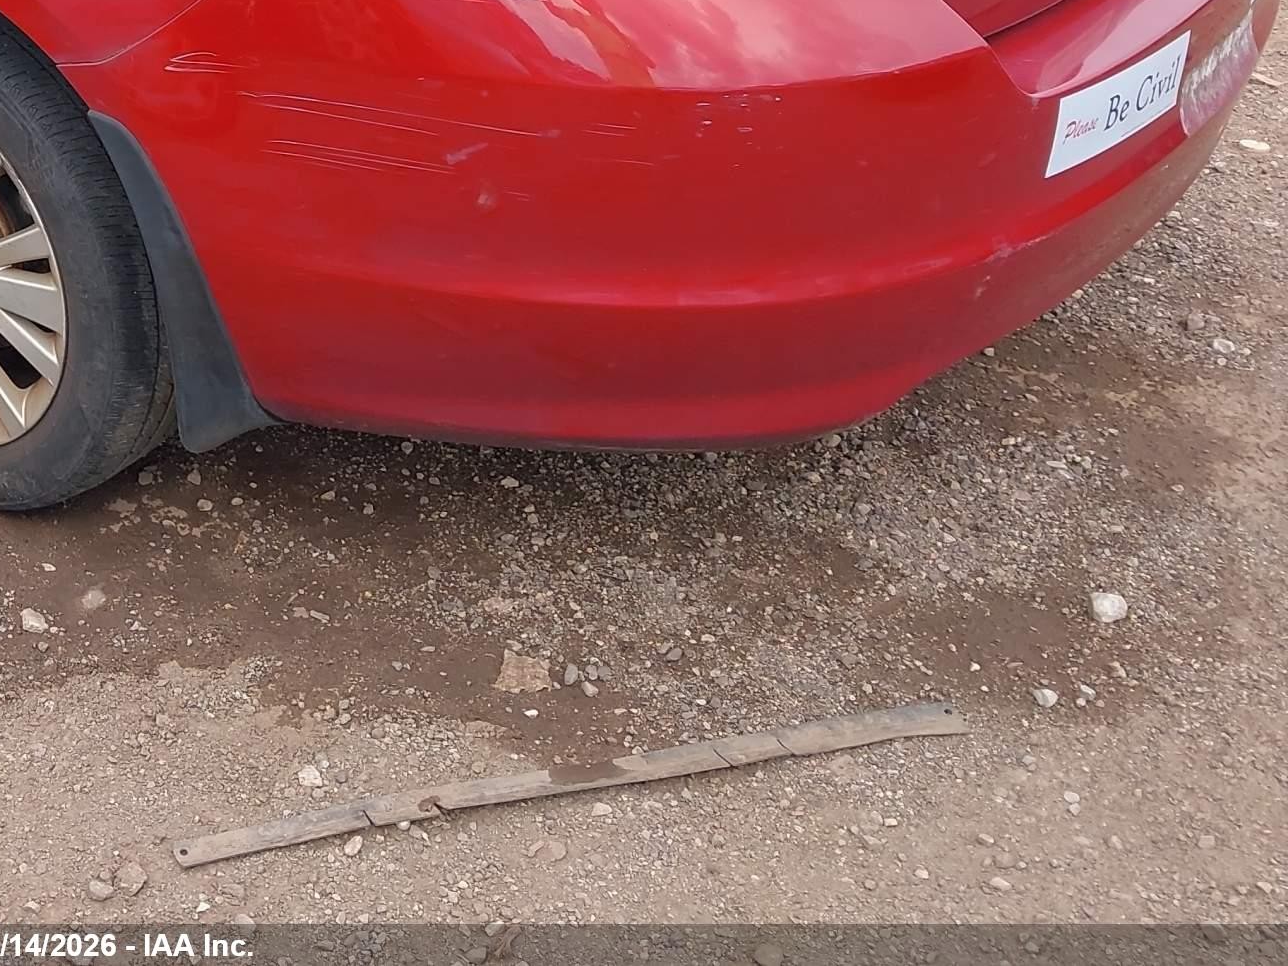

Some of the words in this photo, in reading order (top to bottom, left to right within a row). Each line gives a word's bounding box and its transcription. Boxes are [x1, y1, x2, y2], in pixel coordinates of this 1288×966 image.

[1063, 118, 1099, 144] Please
[1104, 94, 1130, 131] Be
[1136, 54, 1182, 111] Civil
